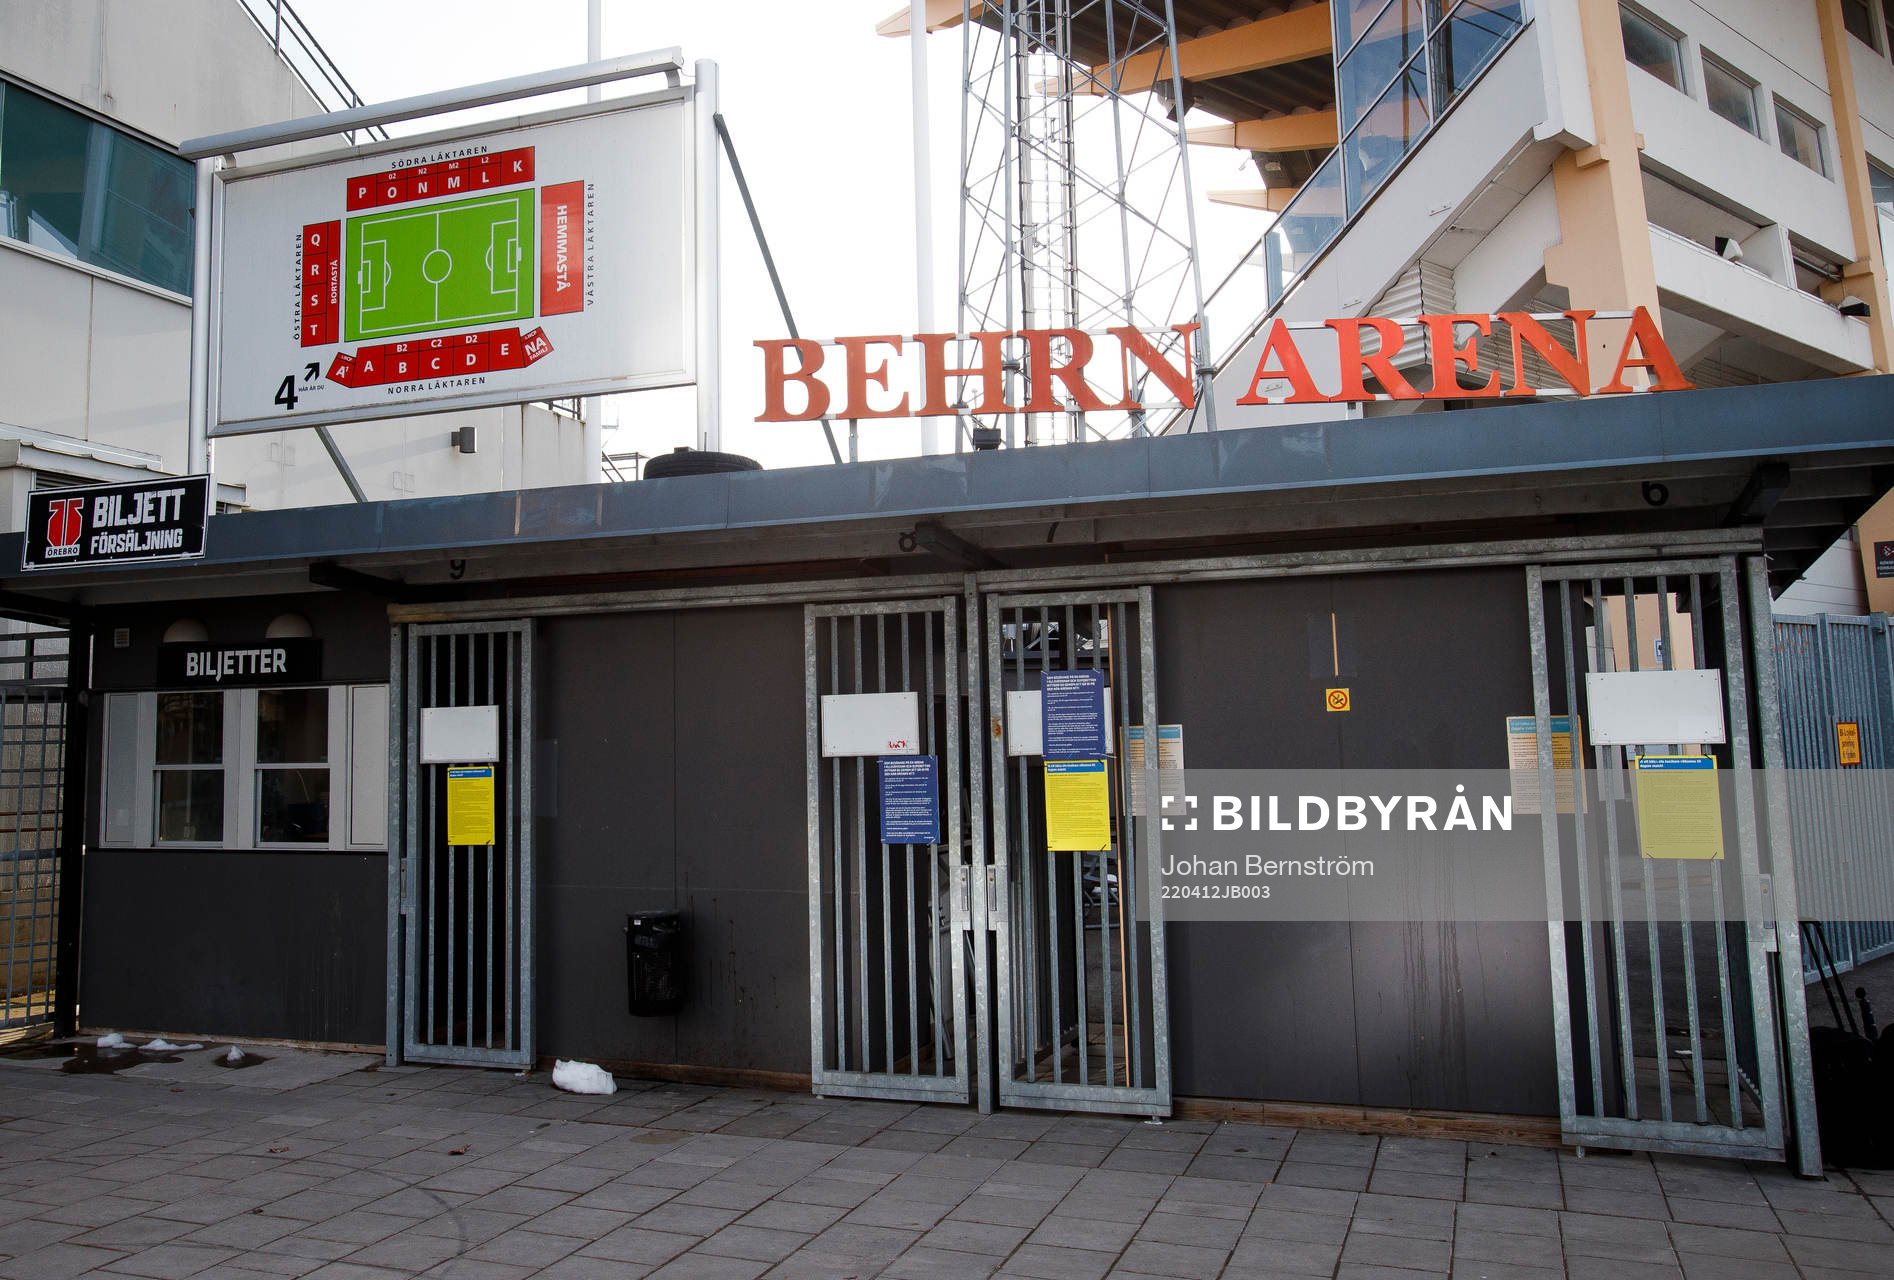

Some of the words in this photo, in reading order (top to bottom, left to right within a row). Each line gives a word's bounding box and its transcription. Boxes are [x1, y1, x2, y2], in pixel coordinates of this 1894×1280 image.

[391, 156, 427, 169] SÖDRA
[431, 145, 488, 162] LÄKTAREN
[418, 167, 428, 175] N2
[448, 162, 459, 170] M2
[513, 160, 523, 172] K
[448, 176, 460, 189] M
[482, 172, 489, 183] L
[358, 187, 367, 199] P
[418, 182, 428, 194] N
[586, 183, 594, 250] LÄKTAREN
[311, 234, 320, 246] Q
[556, 204, 571, 292] HEMMASTÅ
[294, 234, 302, 297] LÄKTAREN
[311, 264, 319, 276] R
[330, 260, 338, 304] BORTASTÅ
[586, 255, 594, 306] VÄSTRA
[311, 295, 318, 306] S
[310, 324, 318, 336] T
[431, 339, 442, 348] C2
[466, 335, 478, 343] D2
[397, 344, 408, 352] B2
[501, 344, 509, 355] E
[524, 337, 546, 356] NA
[364, 360, 374, 372] A
[431, 358, 440, 369] C
[466, 354, 476, 366] D
[753, 323, 1201, 422] BEHRN
[1236, 306, 1697, 405] ARENA
[398, 362, 407, 373] B
[388, 384, 424, 394] NORRA
[428, 376, 486, 390] LÄKTAREN
[274, 375, 298, 410] 4
[92, 488, 186, 528] BILJETT
[90, 528, 183, 555] FÖRSÄLJNING
[47, 546, 78, 556] ÖREBRO
[186, 648, 287, 682] BILJETTER
